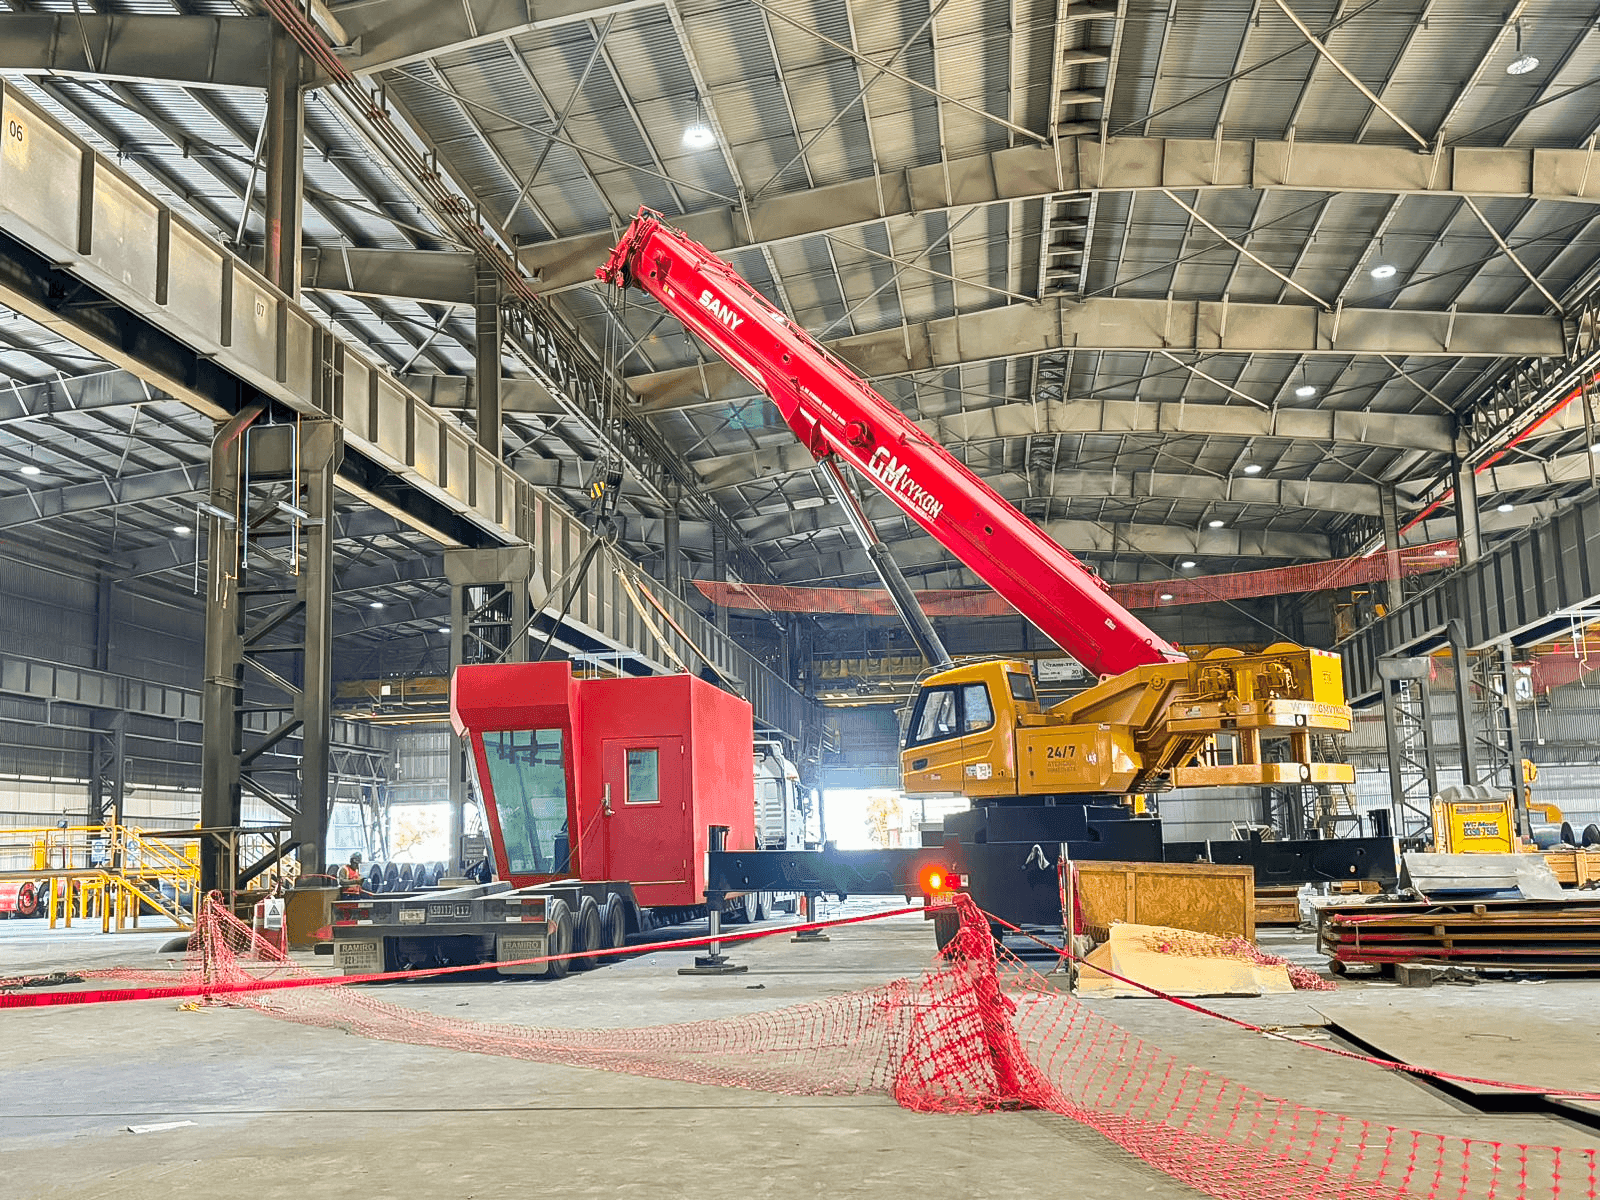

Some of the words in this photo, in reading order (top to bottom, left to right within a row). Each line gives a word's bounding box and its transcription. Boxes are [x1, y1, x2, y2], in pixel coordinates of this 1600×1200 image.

[9, 120, 23, 142] 06
[256, 302, 265, 318] 07
[698, 289, 744, 331] SANY
[1047, 745, 1076, 759] 24/7
[342, 943, 375, 952] RAMIRO
[505, 941, 539, 949] RAMIRO
